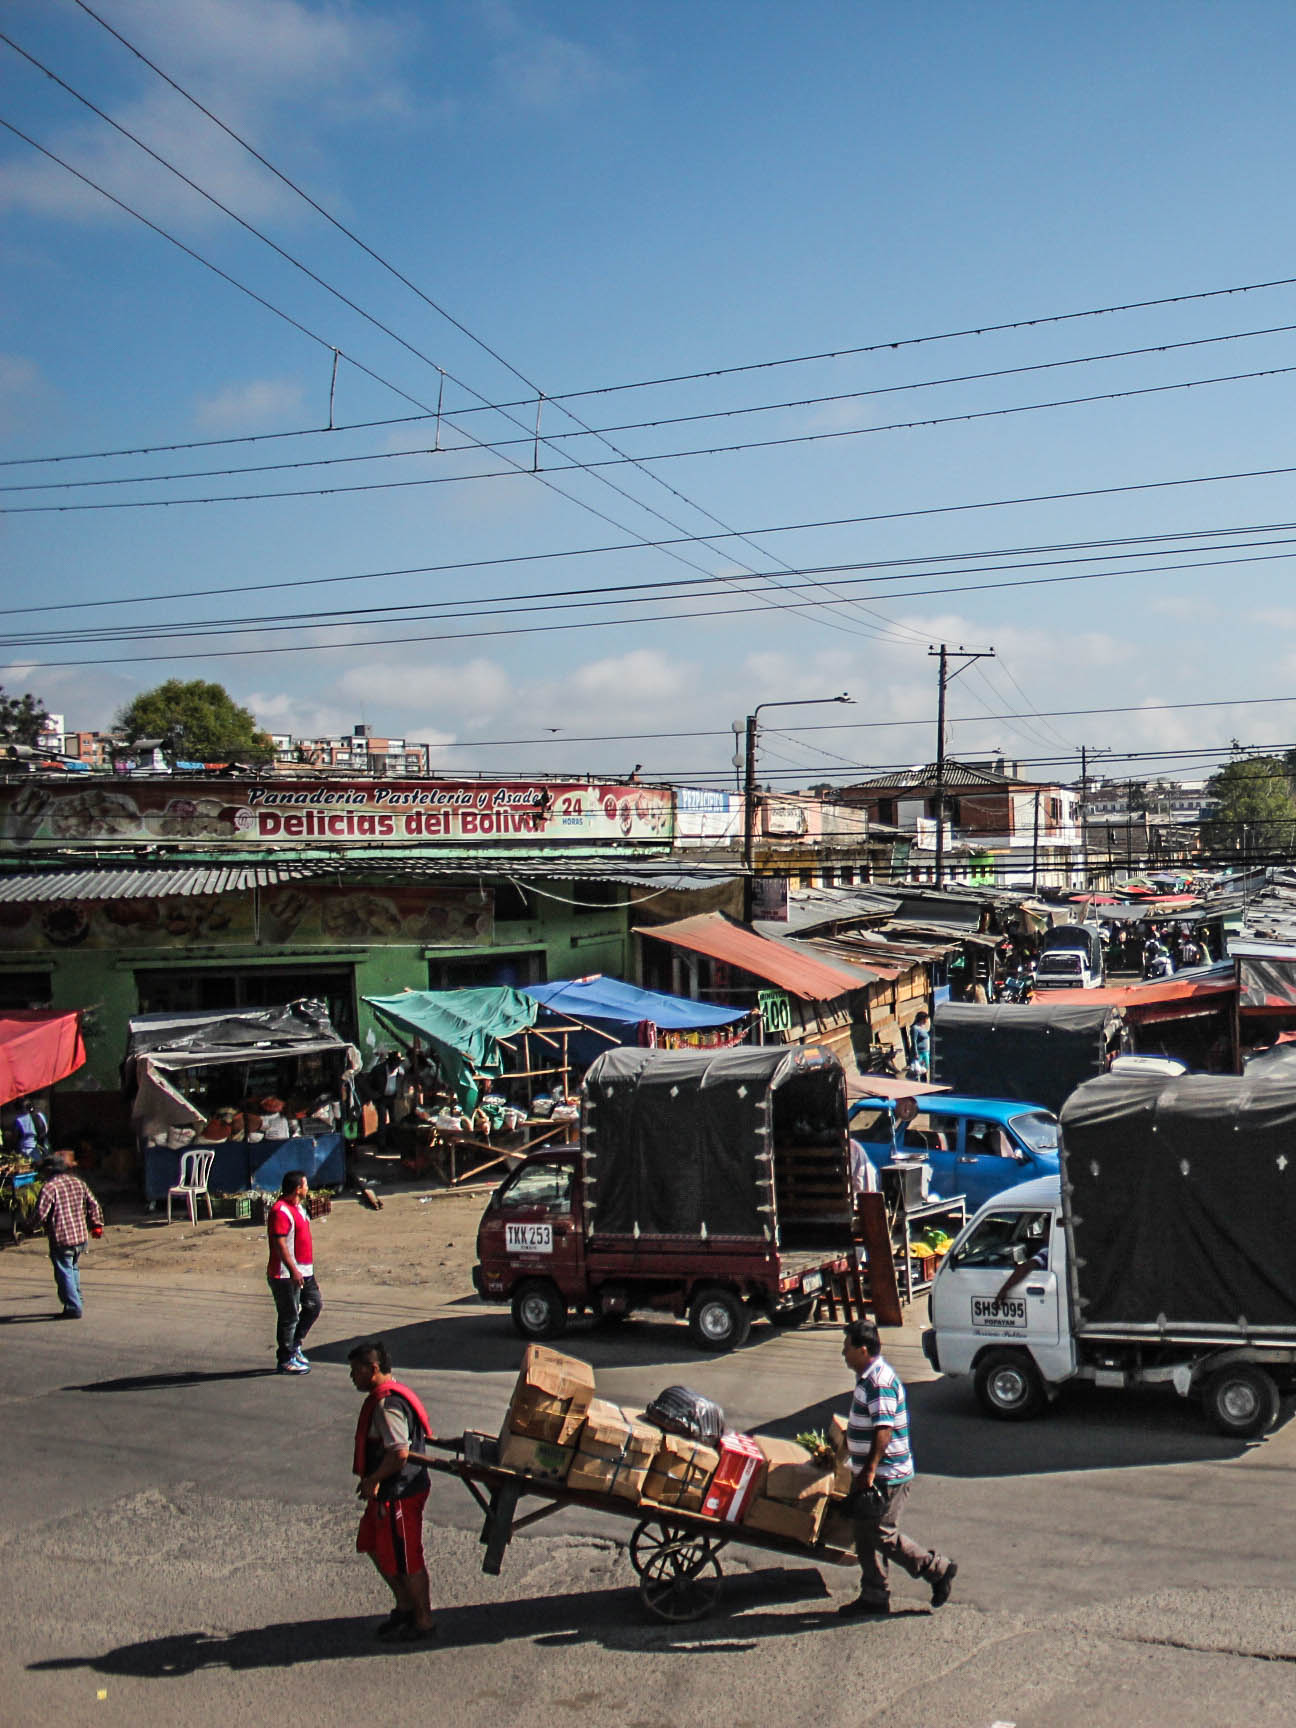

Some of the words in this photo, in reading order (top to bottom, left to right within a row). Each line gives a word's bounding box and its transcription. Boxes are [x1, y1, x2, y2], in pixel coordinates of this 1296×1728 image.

[248, 787, 367, 805] Panaderia
[375, 788, 473, 805] Pasteleria
[478, 792, 488, 808] y
[493, 788, 553, 806] Asado
[562, 797, 582, 816] 24
[258, 810, 394, 836] Delicias
[405, 810, 450, 835] del
[562, 818, 583, 826] HORAS
[762, 999, 789, 1031] 100
[508, 1226, 528, 1245] TKK
[529, 1226, 550, 1245] 253
[1002, 1302, 1024, 1318] 095
[984, 1318, 1015, 1326] POPAYAN
